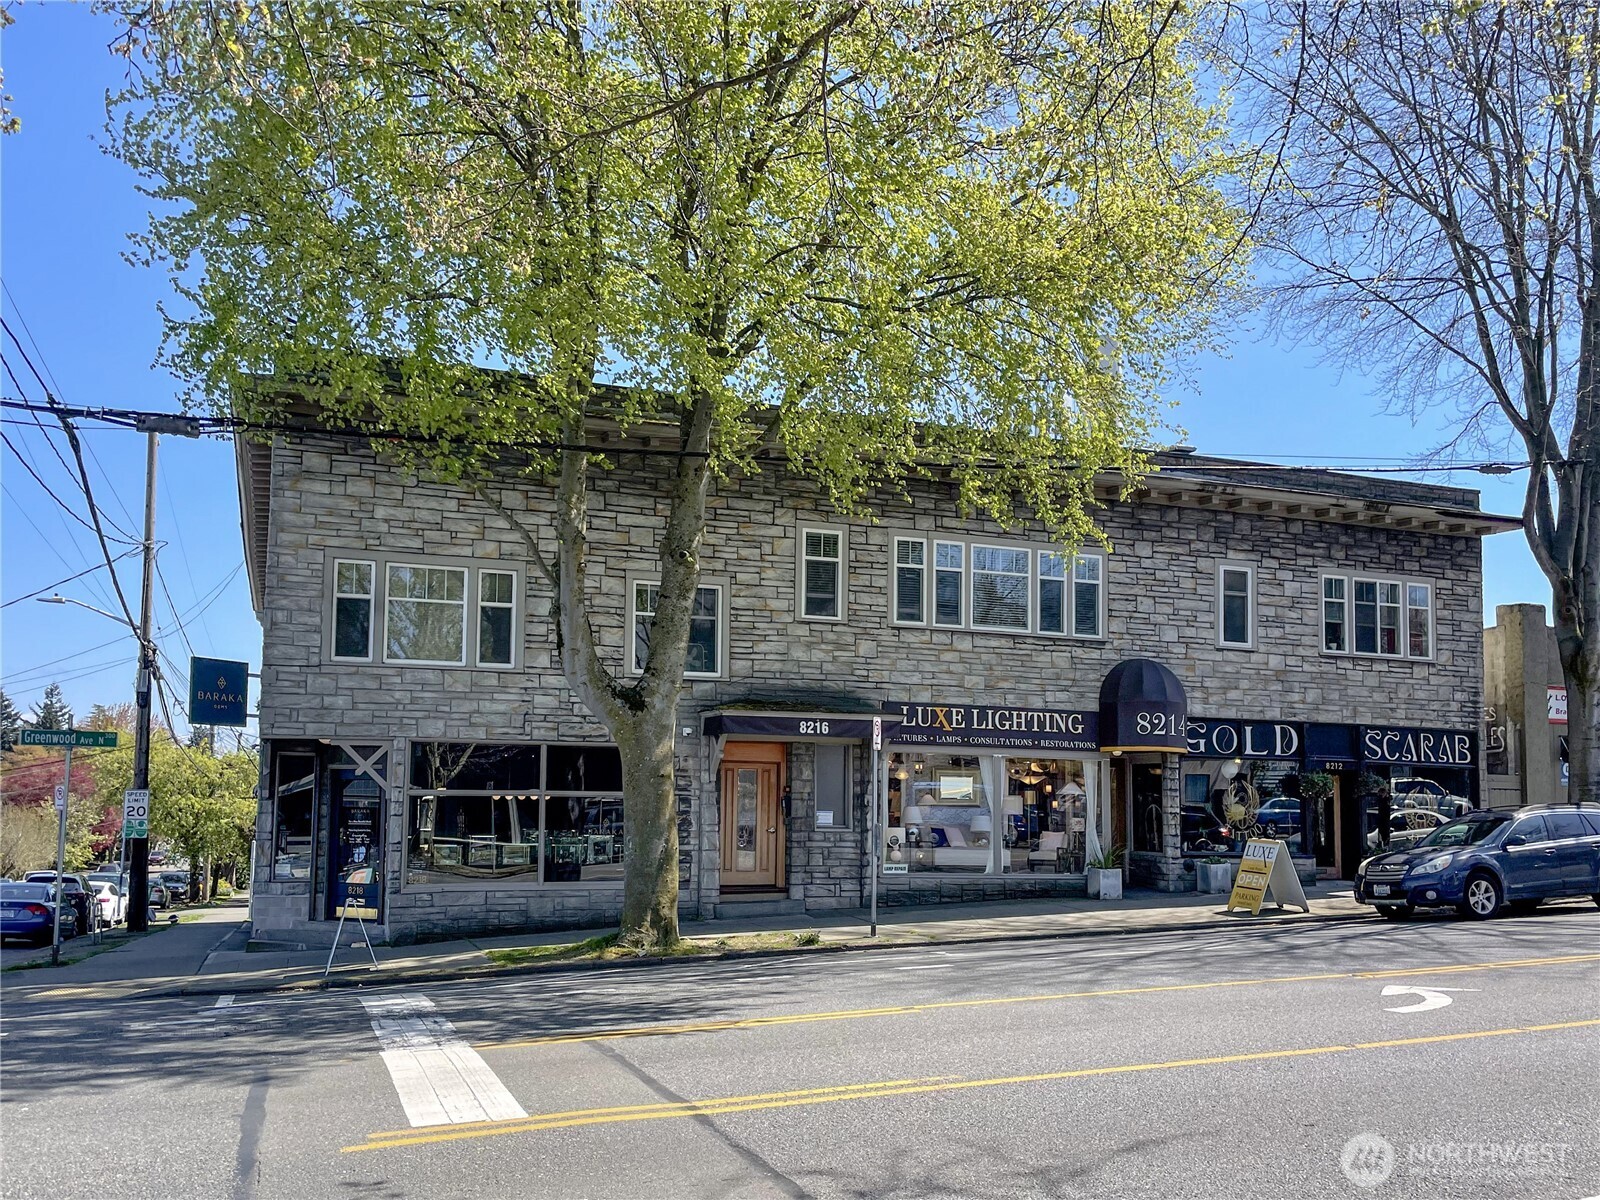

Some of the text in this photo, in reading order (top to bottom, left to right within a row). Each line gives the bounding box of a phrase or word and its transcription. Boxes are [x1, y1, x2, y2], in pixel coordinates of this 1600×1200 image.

[197, 690, 243, 703] BARAKA
[799, 719, 829, 734] 8216
[900, 705, 1085, 734] LUXE LIGHTING
[1136, 712, 1185, 737] 8214
[24, 731, 76, 744] Greenwood
[80, 736, 94, 745] Ave
[98, 736, 104, 745] N
[936, 735, 962, 743] LAMPS
[969, 737, 1033, 747] CONSULTATIONS
[1040, 740, 1097, 749] RESTORATIONS
[1187, 721, 1299, 756] GOLD
[1364, 729, 1472, 764] SCARAB
[1325, 762, 1343, 770] 8212
[127, 806, 146, 817] 20
[1245, 845, 1275, 868] LUXE
[1238, 874, 1266, 887] OPEN
[347, 886, 364, 895] 8218
[1234, 891, 1260, 902] PARKING
